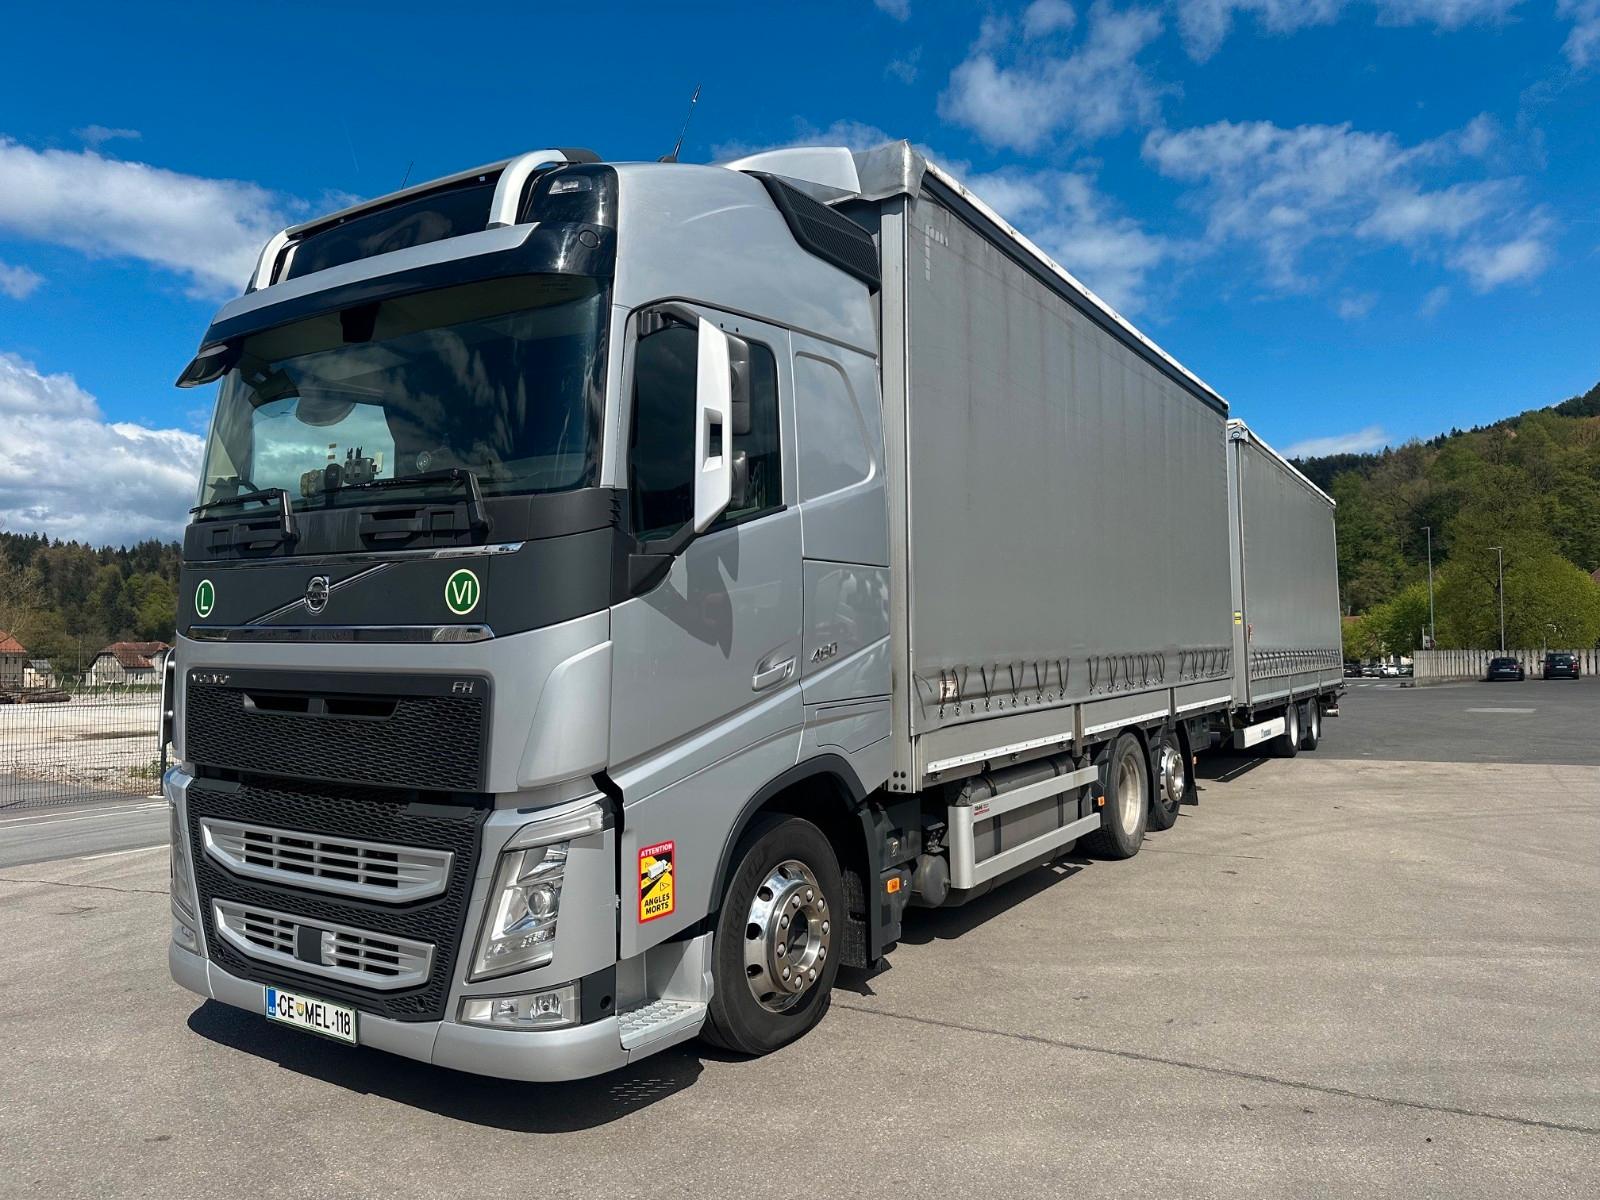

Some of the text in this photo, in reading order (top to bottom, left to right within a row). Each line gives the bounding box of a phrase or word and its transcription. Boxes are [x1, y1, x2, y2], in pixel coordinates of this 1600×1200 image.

[201, 588, 209, 610] L
[452, 580, 472, 605] VI
[451, 681, 475, 694] FH
[640, 843, 673, 857] ATTENTION
[644, 893, 670, 907] ANGLES
[645, 902, 669, 915] MORTS
[279, 994, 295, 1019] CE
